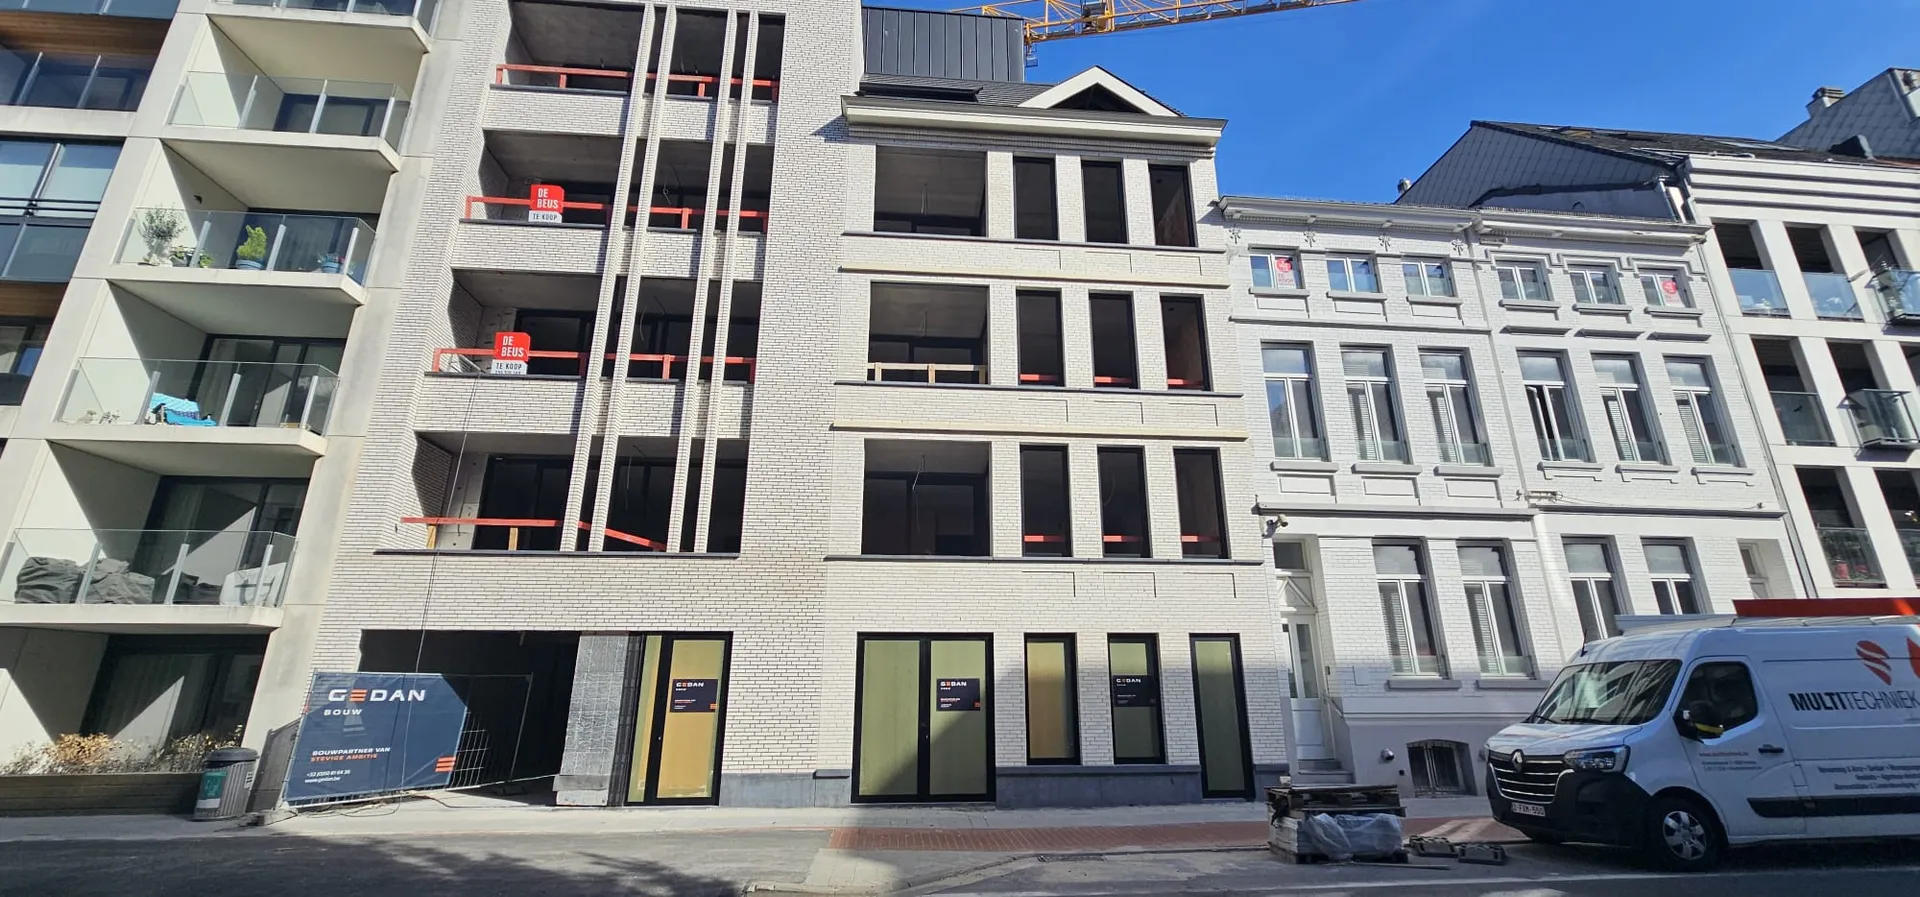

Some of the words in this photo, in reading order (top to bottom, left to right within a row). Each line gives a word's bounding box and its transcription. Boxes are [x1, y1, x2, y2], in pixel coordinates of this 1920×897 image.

[537, 188, 549, 198] DE
[537, 199, 559, 209] BEUS
[502, 336, 514, 346] DE
[501, 346, 524, 357] BEUS
[496, 362, 503, 370] TE
[505, 363, 522, 371] KOOP
[328, 689, 426, 702] GEDAN
[1788, 690, 1920, 711] MULTITECHNIEK
[323, 708, 363, 716] BOUW
[312, 748, 374, 756] BOUWPARTNER
[310, 755, 344, 763] STEVIGE
[345, 753, 378, 761] AMBITIE
